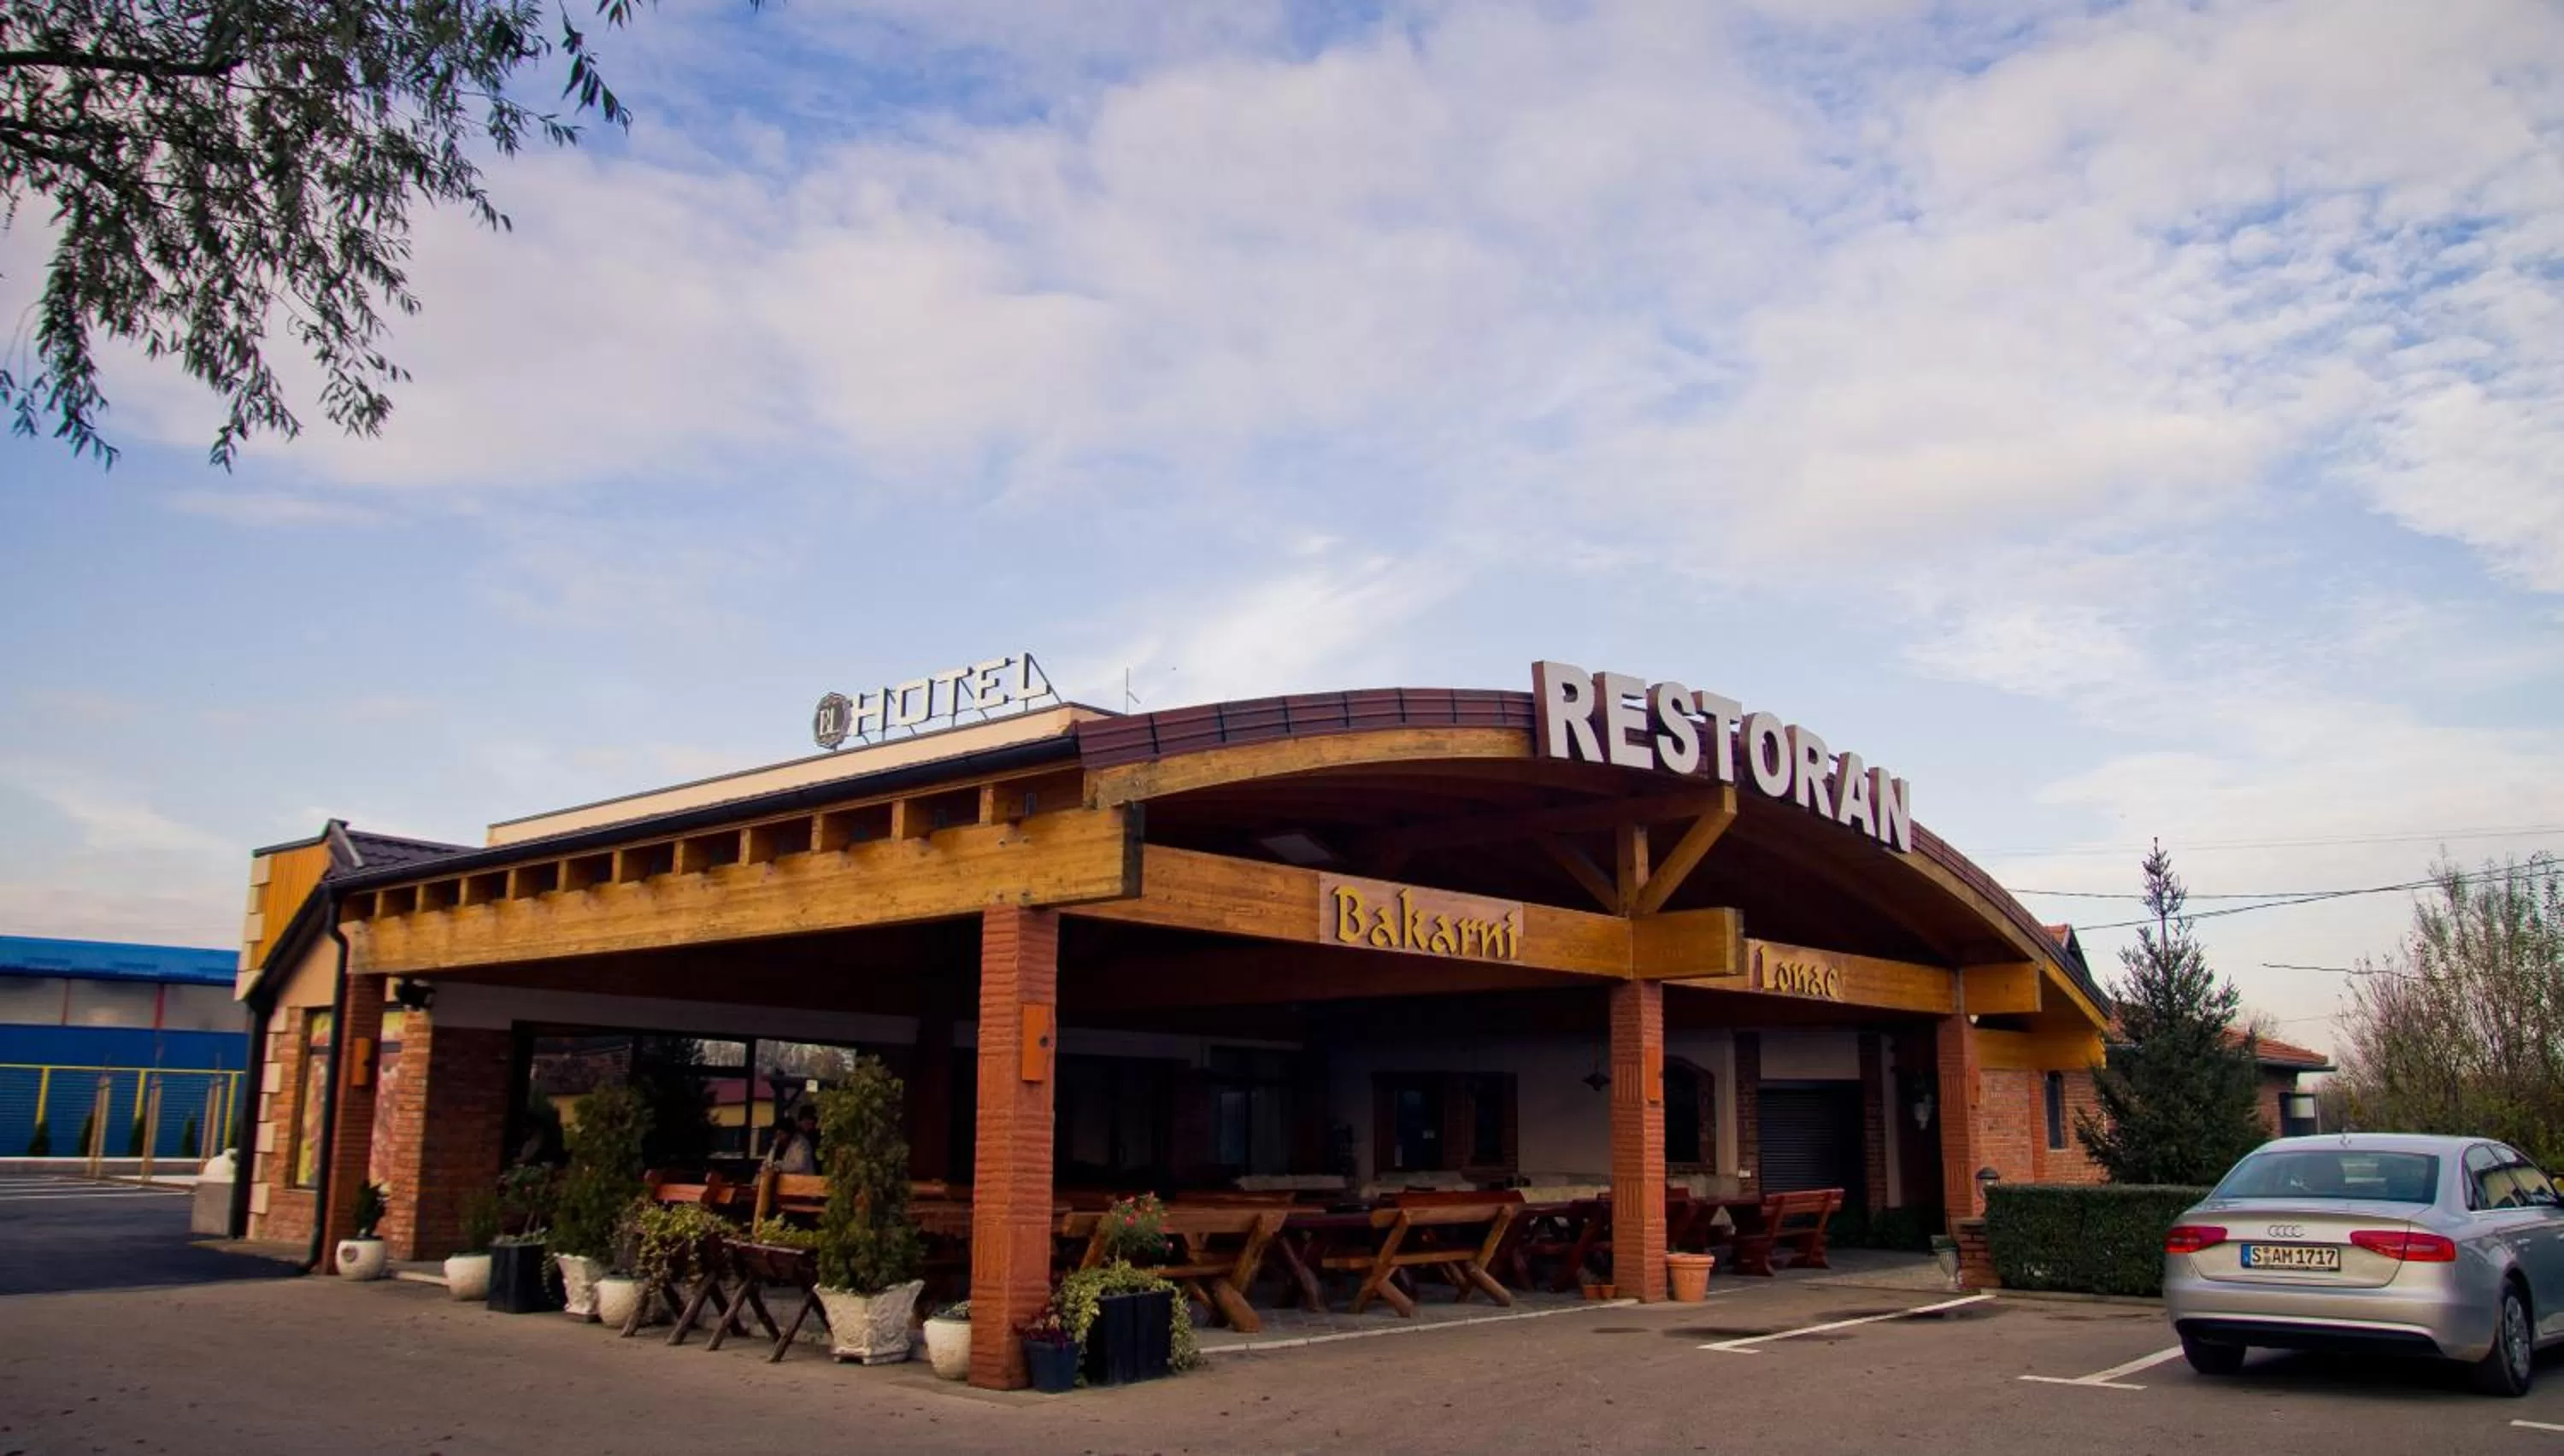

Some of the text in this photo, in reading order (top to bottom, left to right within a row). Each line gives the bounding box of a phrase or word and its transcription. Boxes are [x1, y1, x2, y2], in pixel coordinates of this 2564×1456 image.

[849, 652, 1052, 737] HOTEL
[1532, 660, 1910, 853] RESTORAN
[1331, 884, 1517, 960] Bakarni
